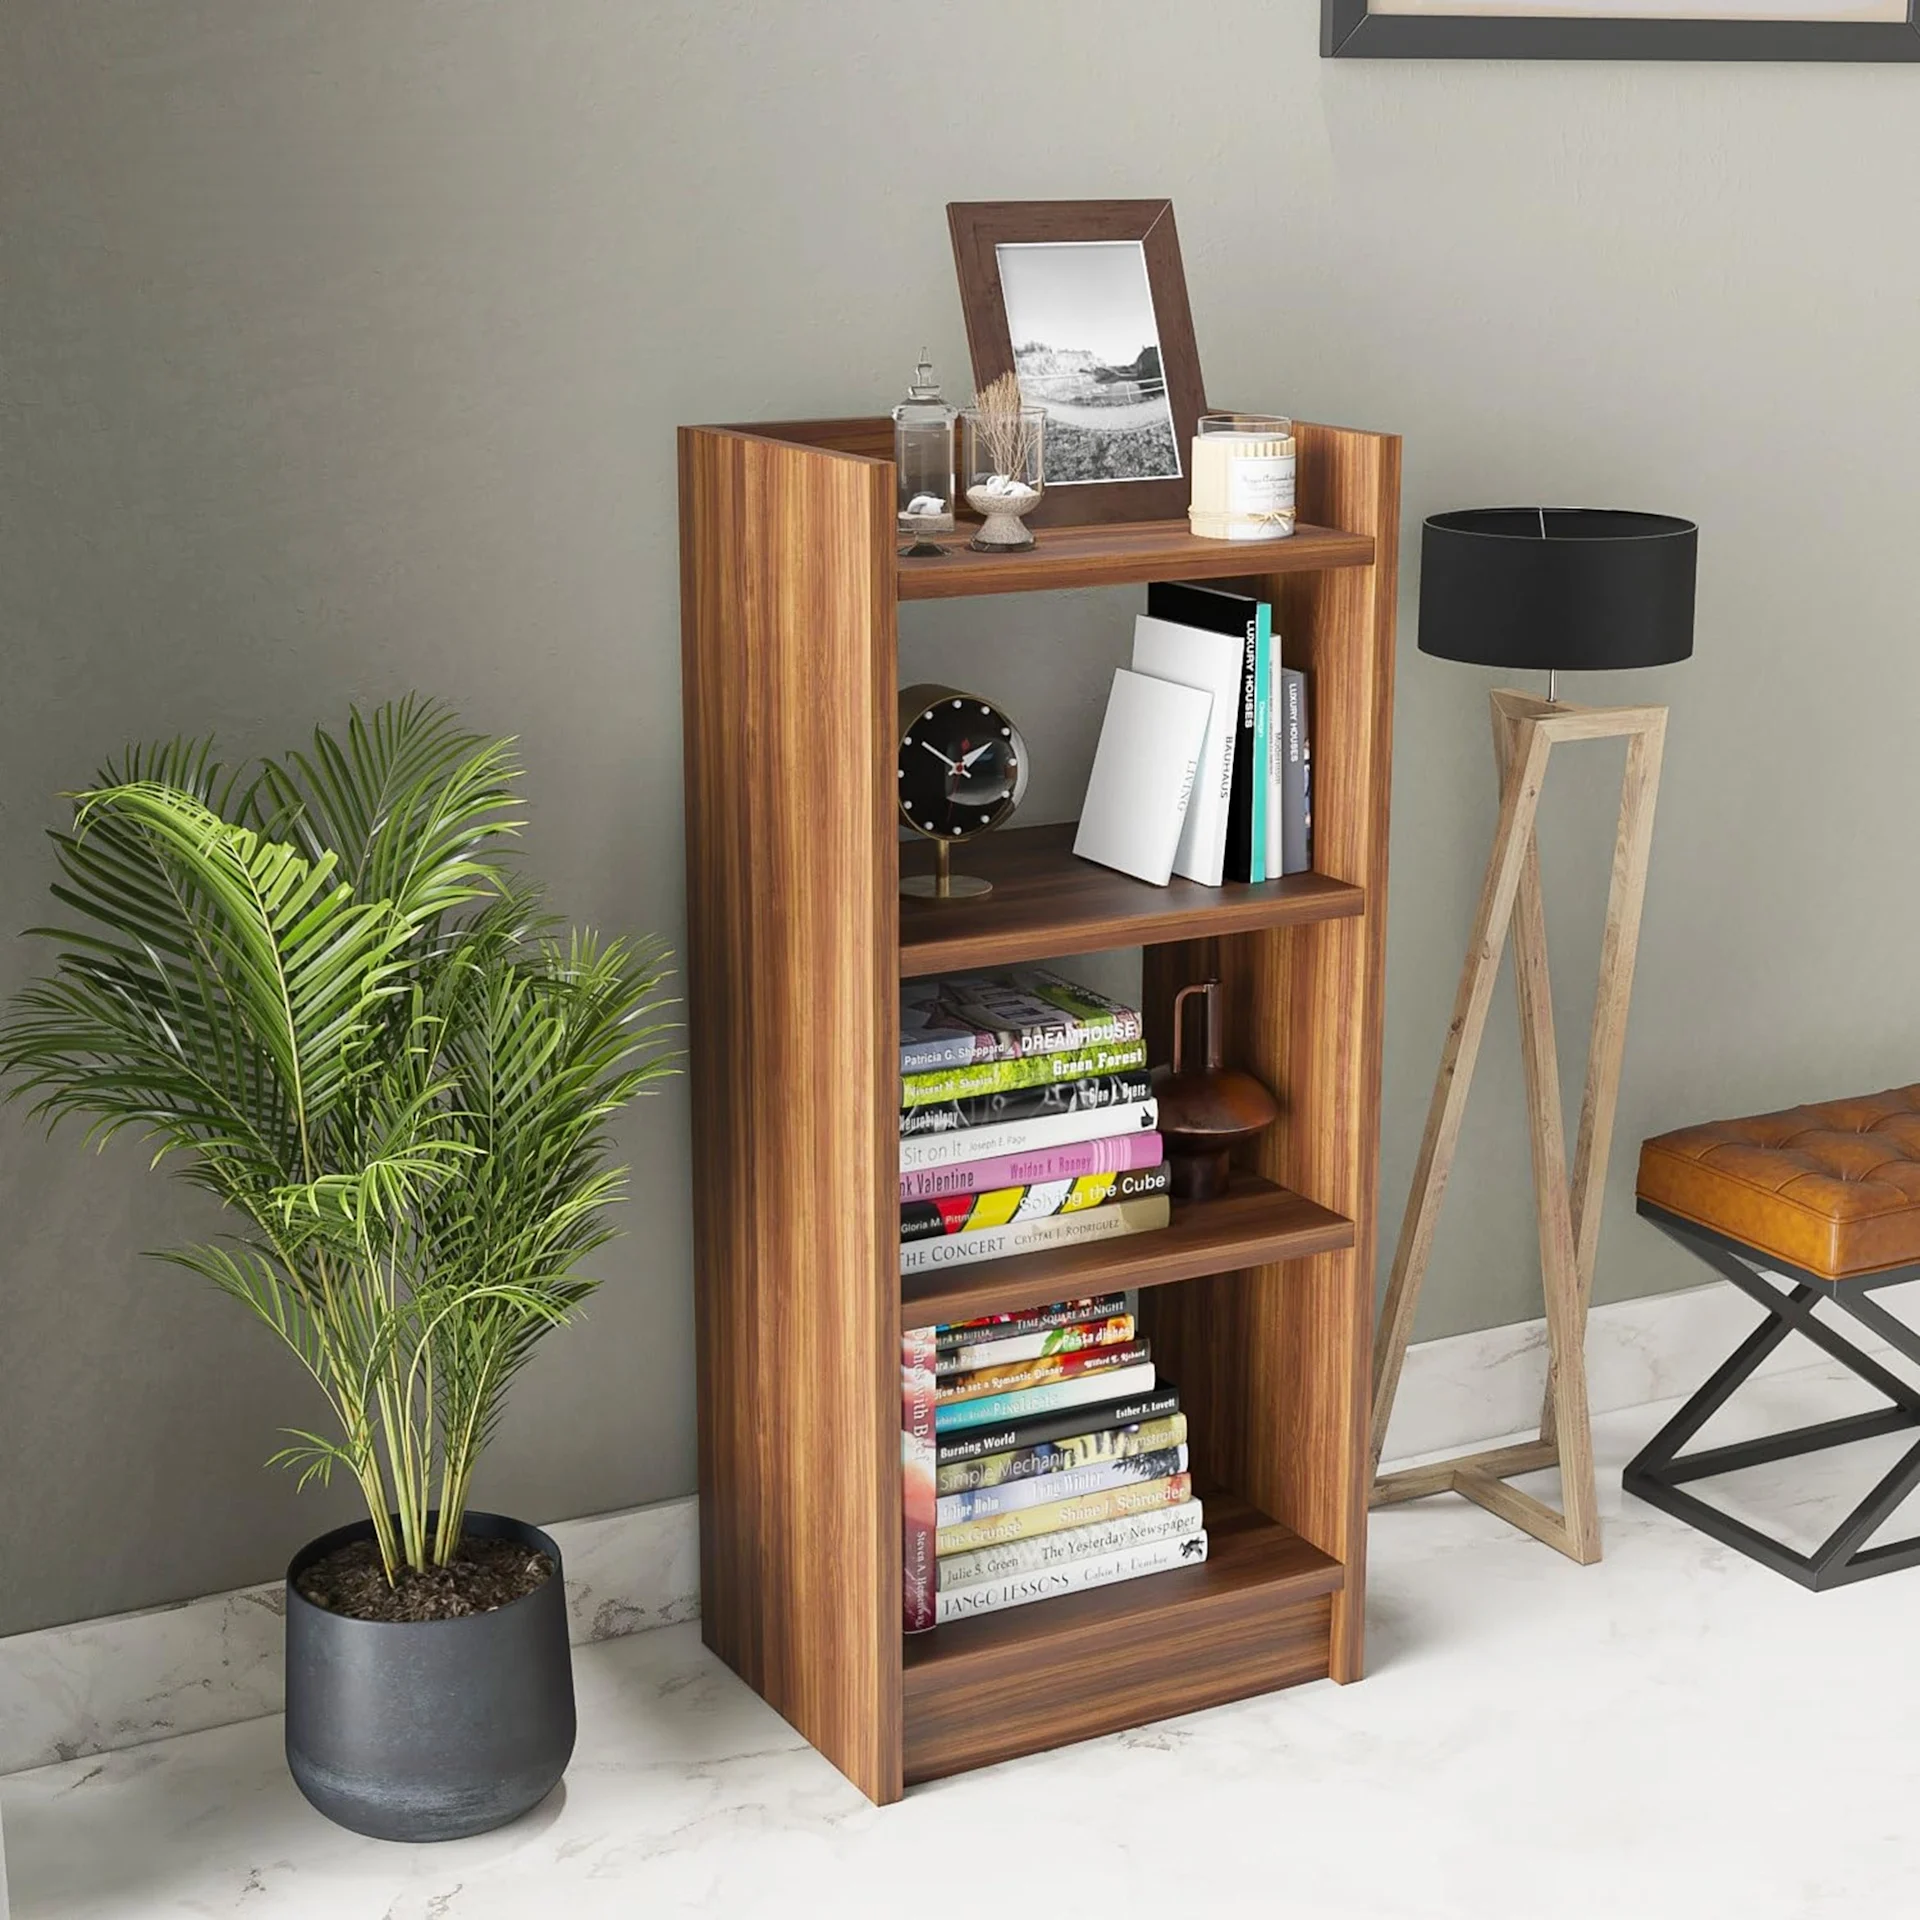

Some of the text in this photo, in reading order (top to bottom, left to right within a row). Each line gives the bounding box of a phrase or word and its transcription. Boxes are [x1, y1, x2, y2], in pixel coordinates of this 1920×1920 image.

[1244, 620, 1255, 729] LUXURY HOUSES
[1289, 683, 1299, 763] LUXURY HOUSES
[1220, 736, 1234, 799] BAUHAUS
[1177, 760, 1197, 811] LIVING
[1021, 1020, 1137, 1053] DREAMHOUSE
[904, 1043, 1005, 1066] Patricia G. Sheppard
[1053, 1047, 1143, 1077] Green Forest
[903, 1138, 962, 1166] Sit on It
[899, 1168, 974, 1197] nk Valentine
[1089, 1182, 1117, 1200] the
[1121, 1173, 1166, 1195] Cube
[900, 1219, 928, 1234] Gloria
[931, 1235, 1006, 1263] CONCERT
[1116, 1405, 1141, 1419] Esther
[1151, 1397, 1175, 1411] Lovett
[940, 1431, 1016, 1459] Burning World
[1042, 1514, 1196, 1561] The Yesterday Newspaper
[947, 1567, 972, 1585] Julie
[987, 1557, 1019, 1574] Green
[945, 1572, 1070, 1616] TANGO LESSONS
